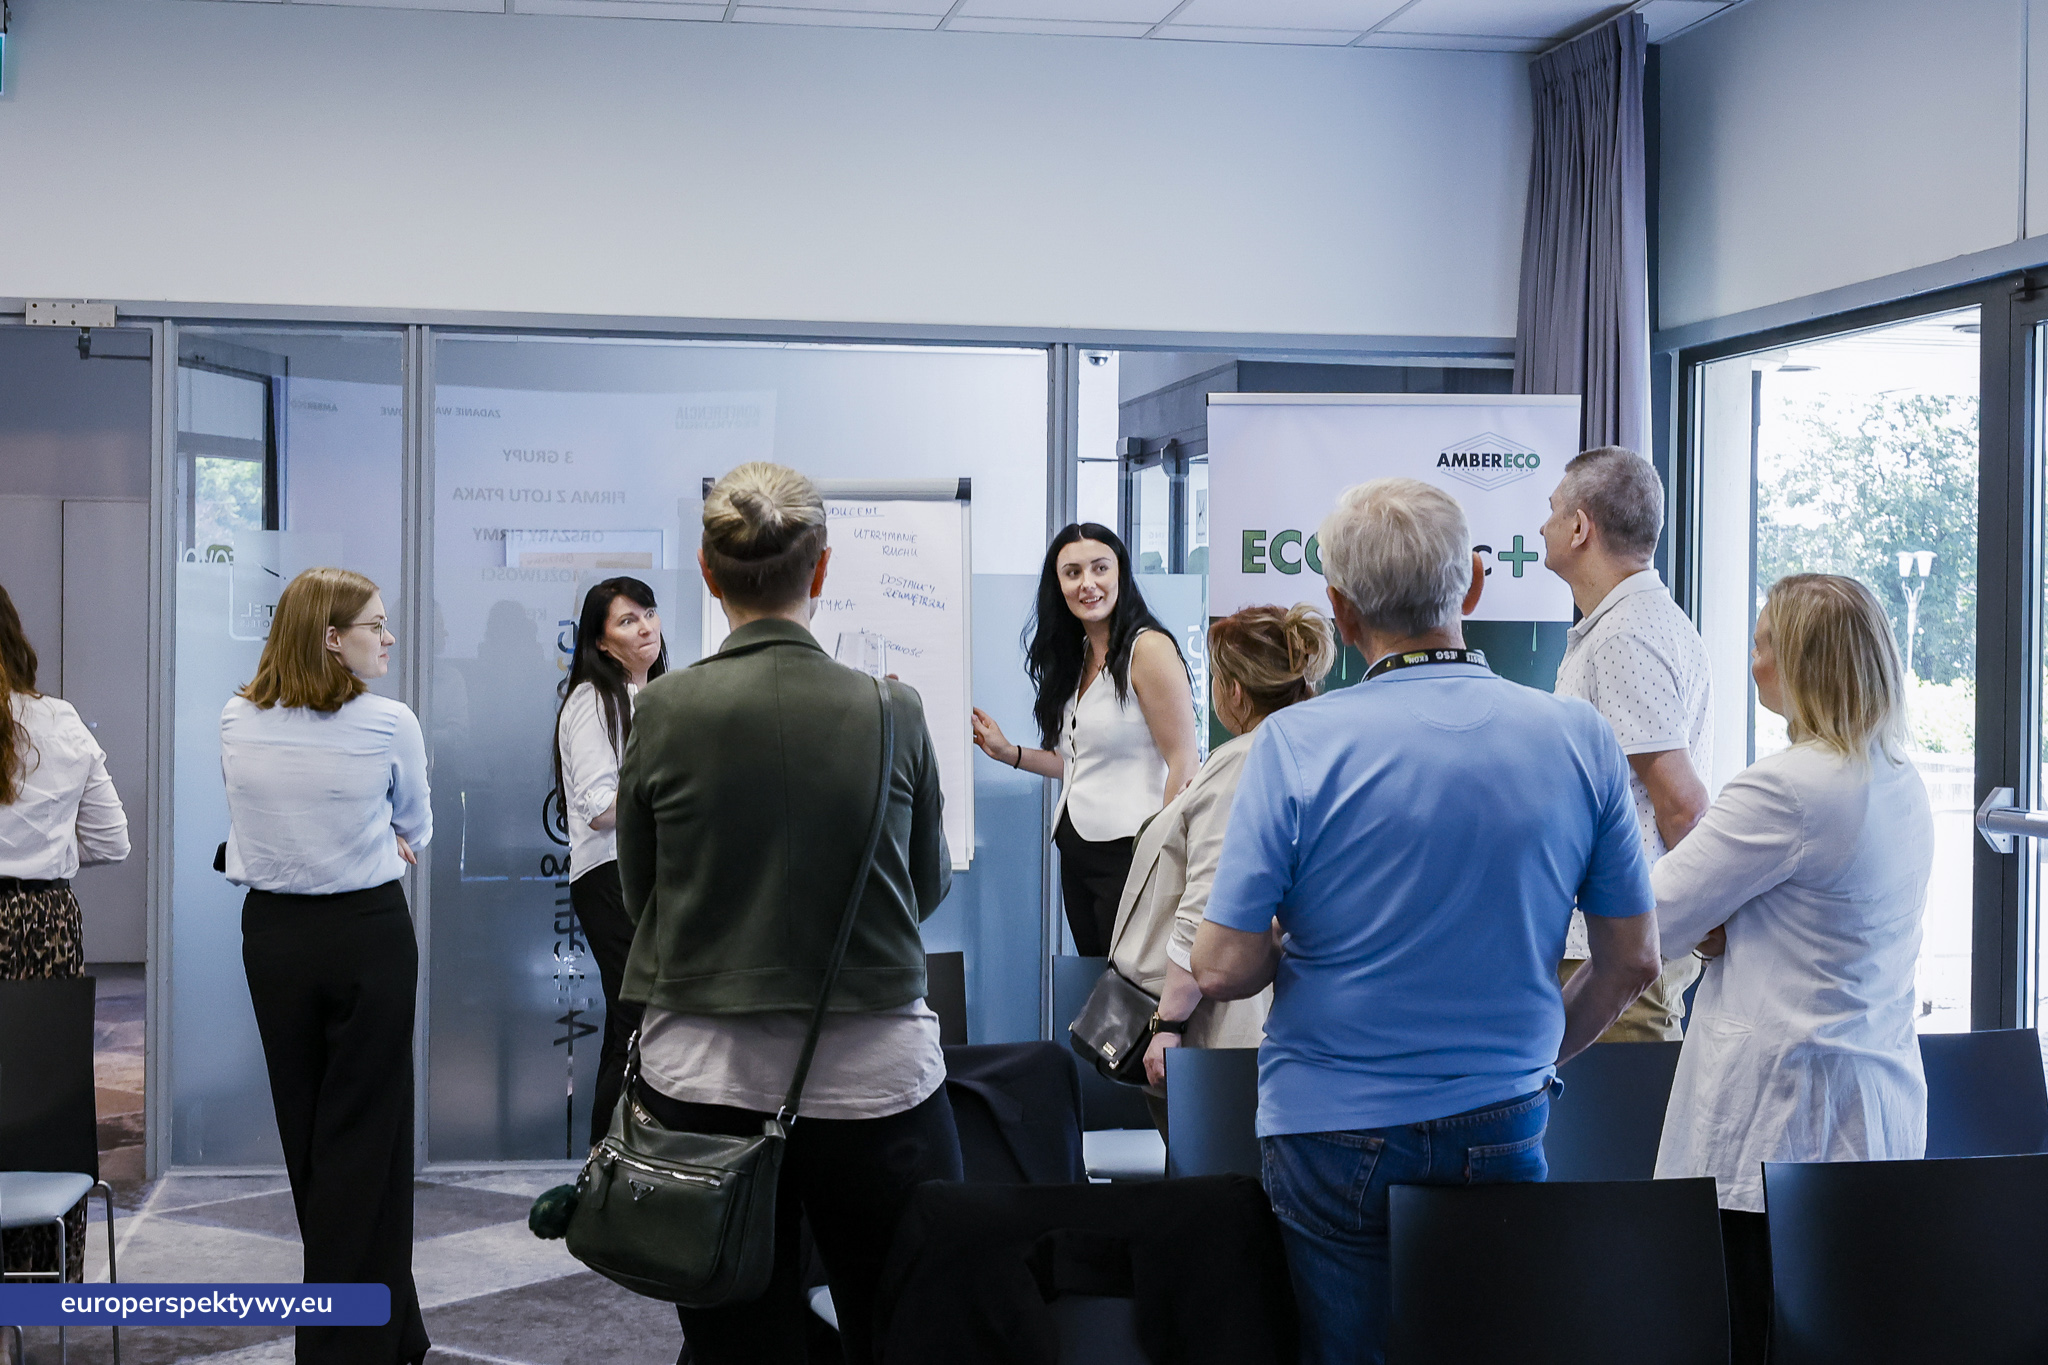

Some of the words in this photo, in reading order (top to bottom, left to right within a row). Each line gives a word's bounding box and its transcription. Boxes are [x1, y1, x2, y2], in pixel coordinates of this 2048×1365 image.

[1436, 452, 1541, 469] AMBERECO
[828, 506, 879, 517] DUCENT
[818, 598, 856, 612] TYKA
